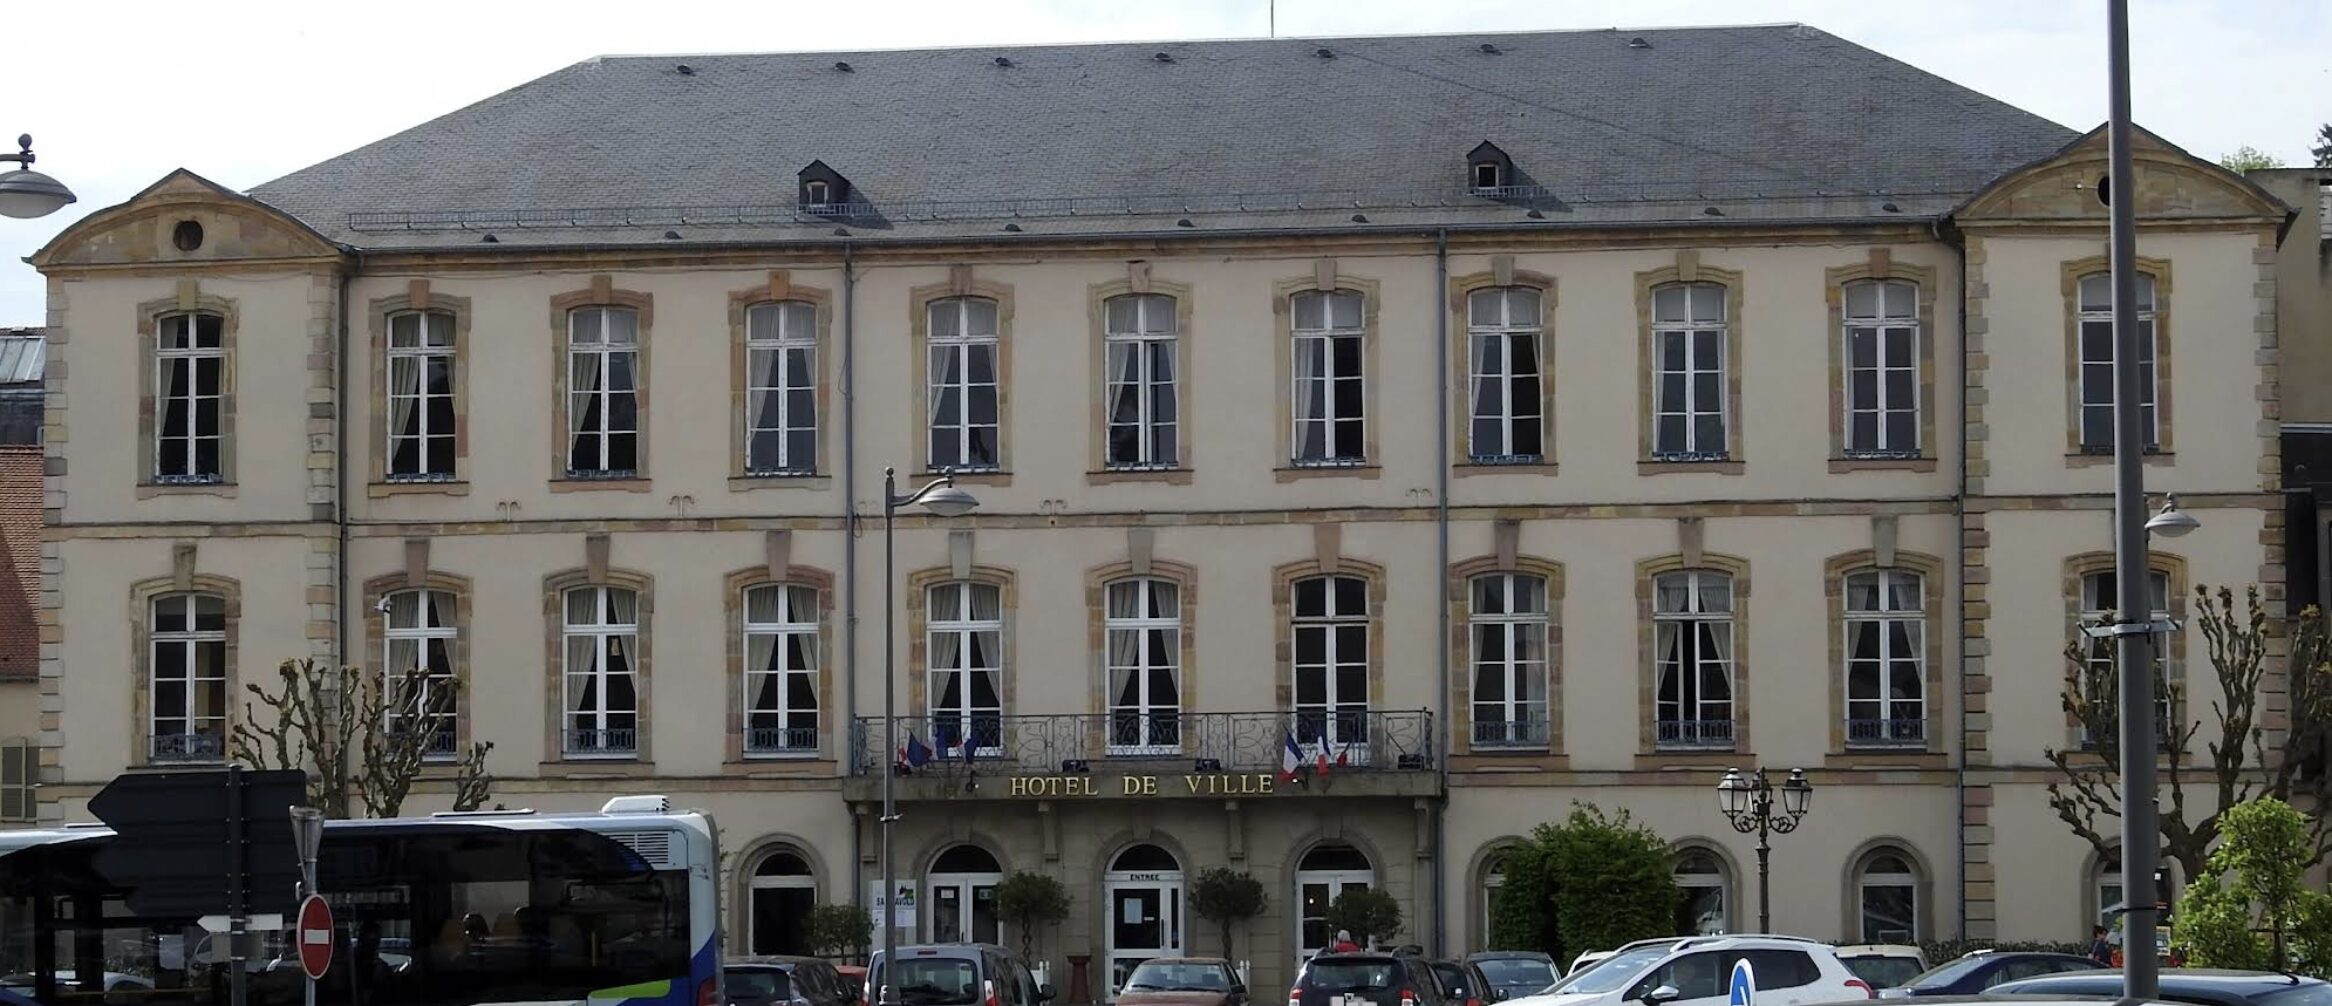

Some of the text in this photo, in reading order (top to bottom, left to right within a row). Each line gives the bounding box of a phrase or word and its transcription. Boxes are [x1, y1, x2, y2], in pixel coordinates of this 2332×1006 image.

[1010, 773, 1275, 797] HOTEL DE VILLE
